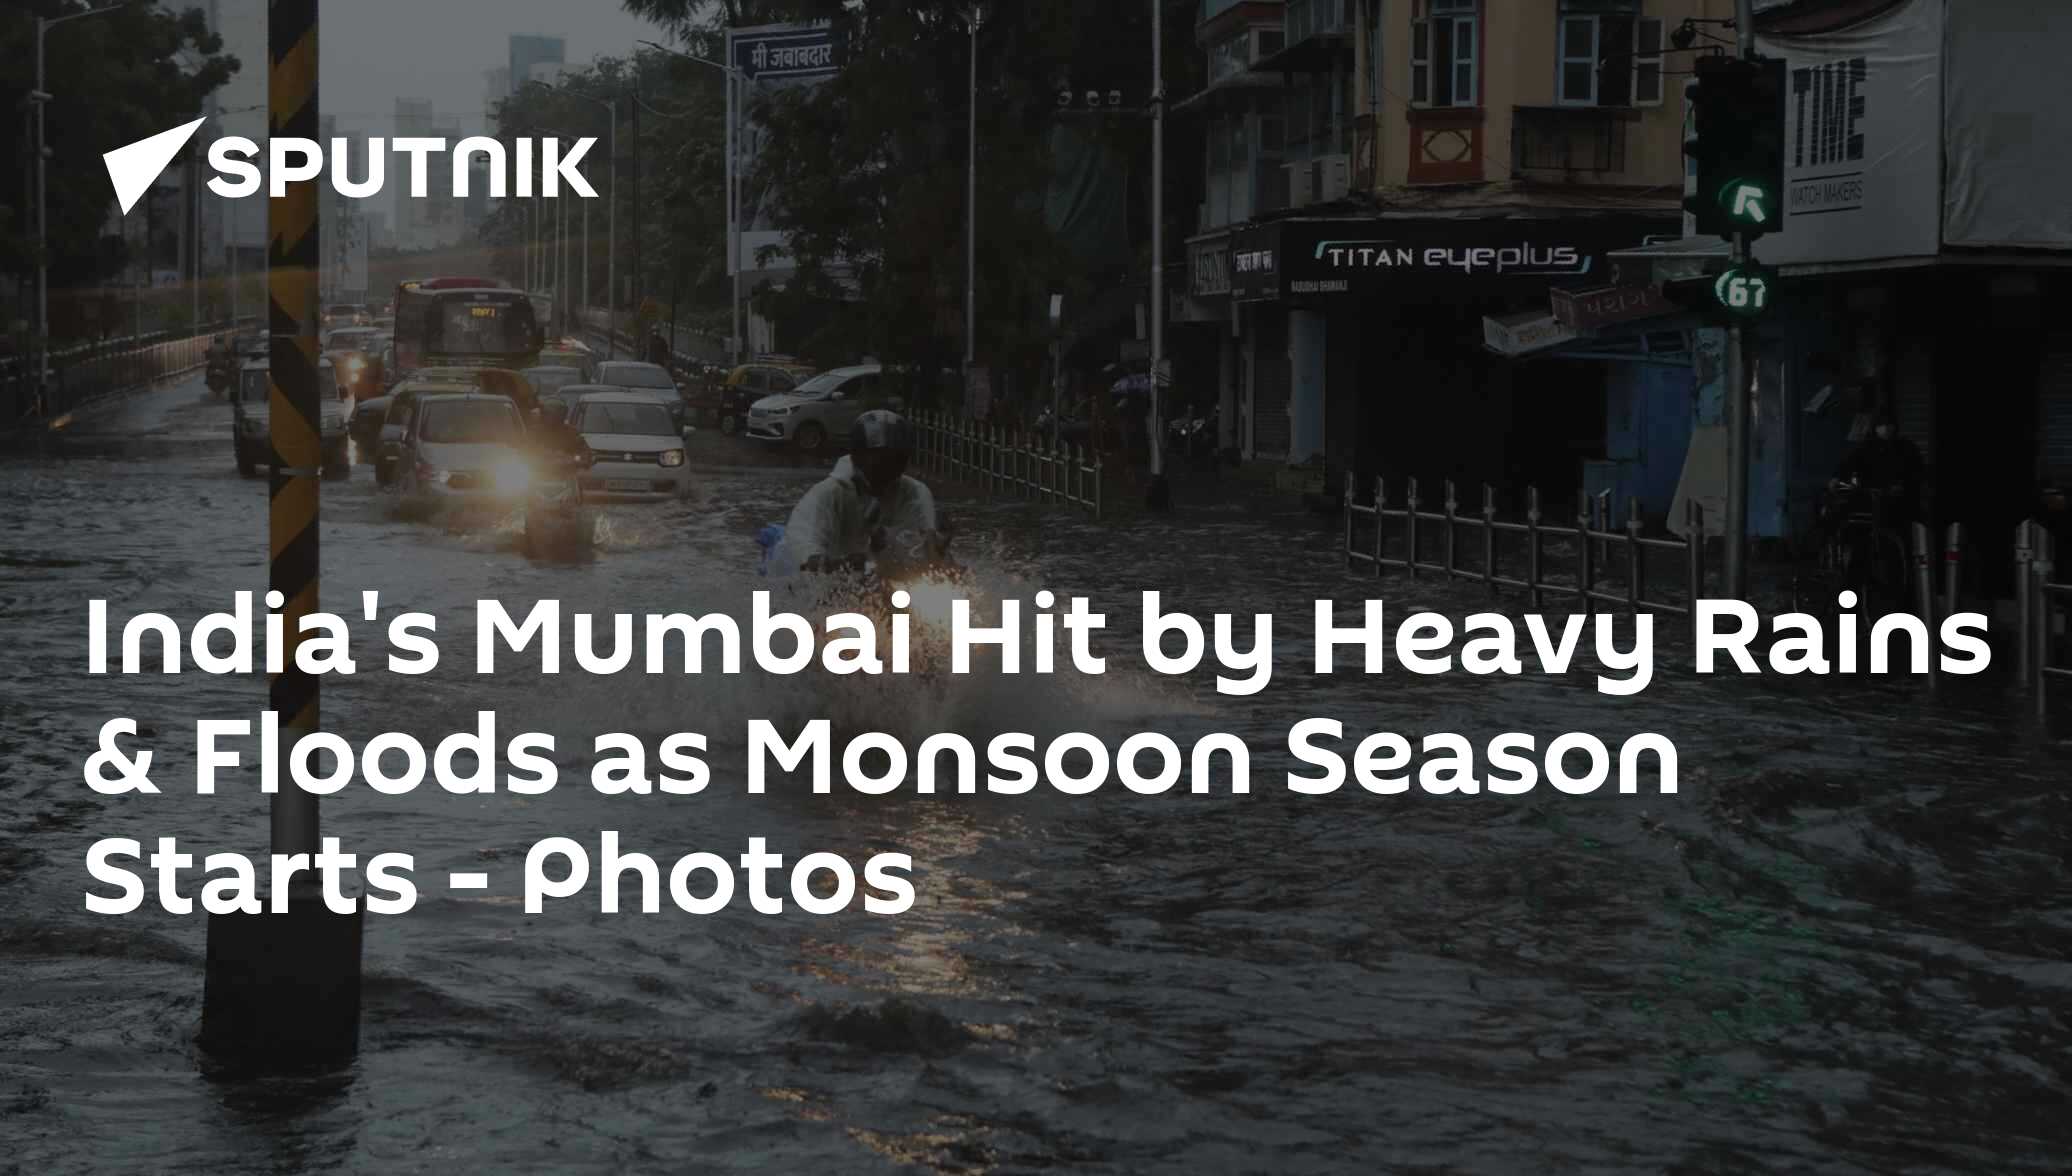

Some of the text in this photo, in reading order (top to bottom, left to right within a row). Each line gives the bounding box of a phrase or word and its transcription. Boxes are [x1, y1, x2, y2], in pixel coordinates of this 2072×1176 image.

[752, 42, 767, 69] मी
[1791, 58, 1867, 167] TIME
[1791, 180, 1863, 207] WATCH MAKERS
[1328, 241, 1580, 275] TITAN eyeplus
[1728, 277, 1767, 308] 67
